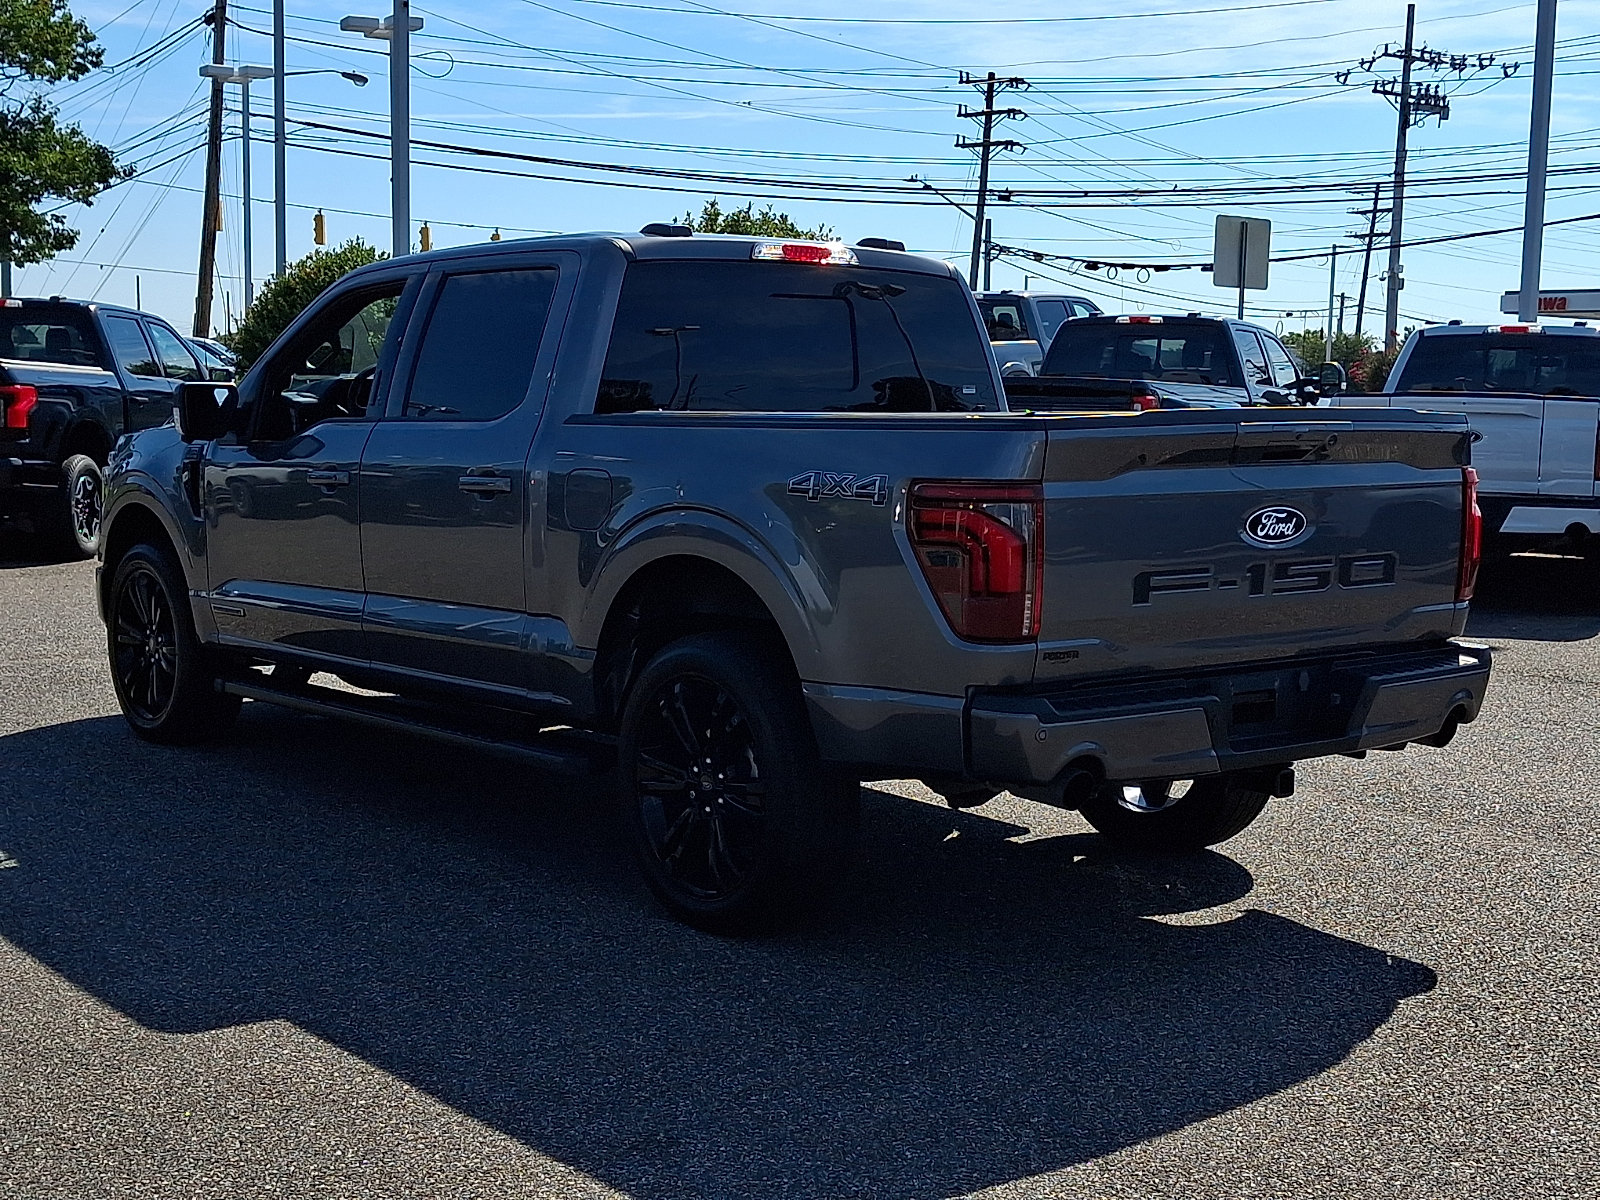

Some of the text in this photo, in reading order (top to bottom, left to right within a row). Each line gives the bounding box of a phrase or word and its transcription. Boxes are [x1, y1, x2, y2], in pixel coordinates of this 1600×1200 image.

[1538, 296, 1567, 311] wa
[1257, 512, 1297, 537] Ford
[1131, 553, 1398, 607] F-150
